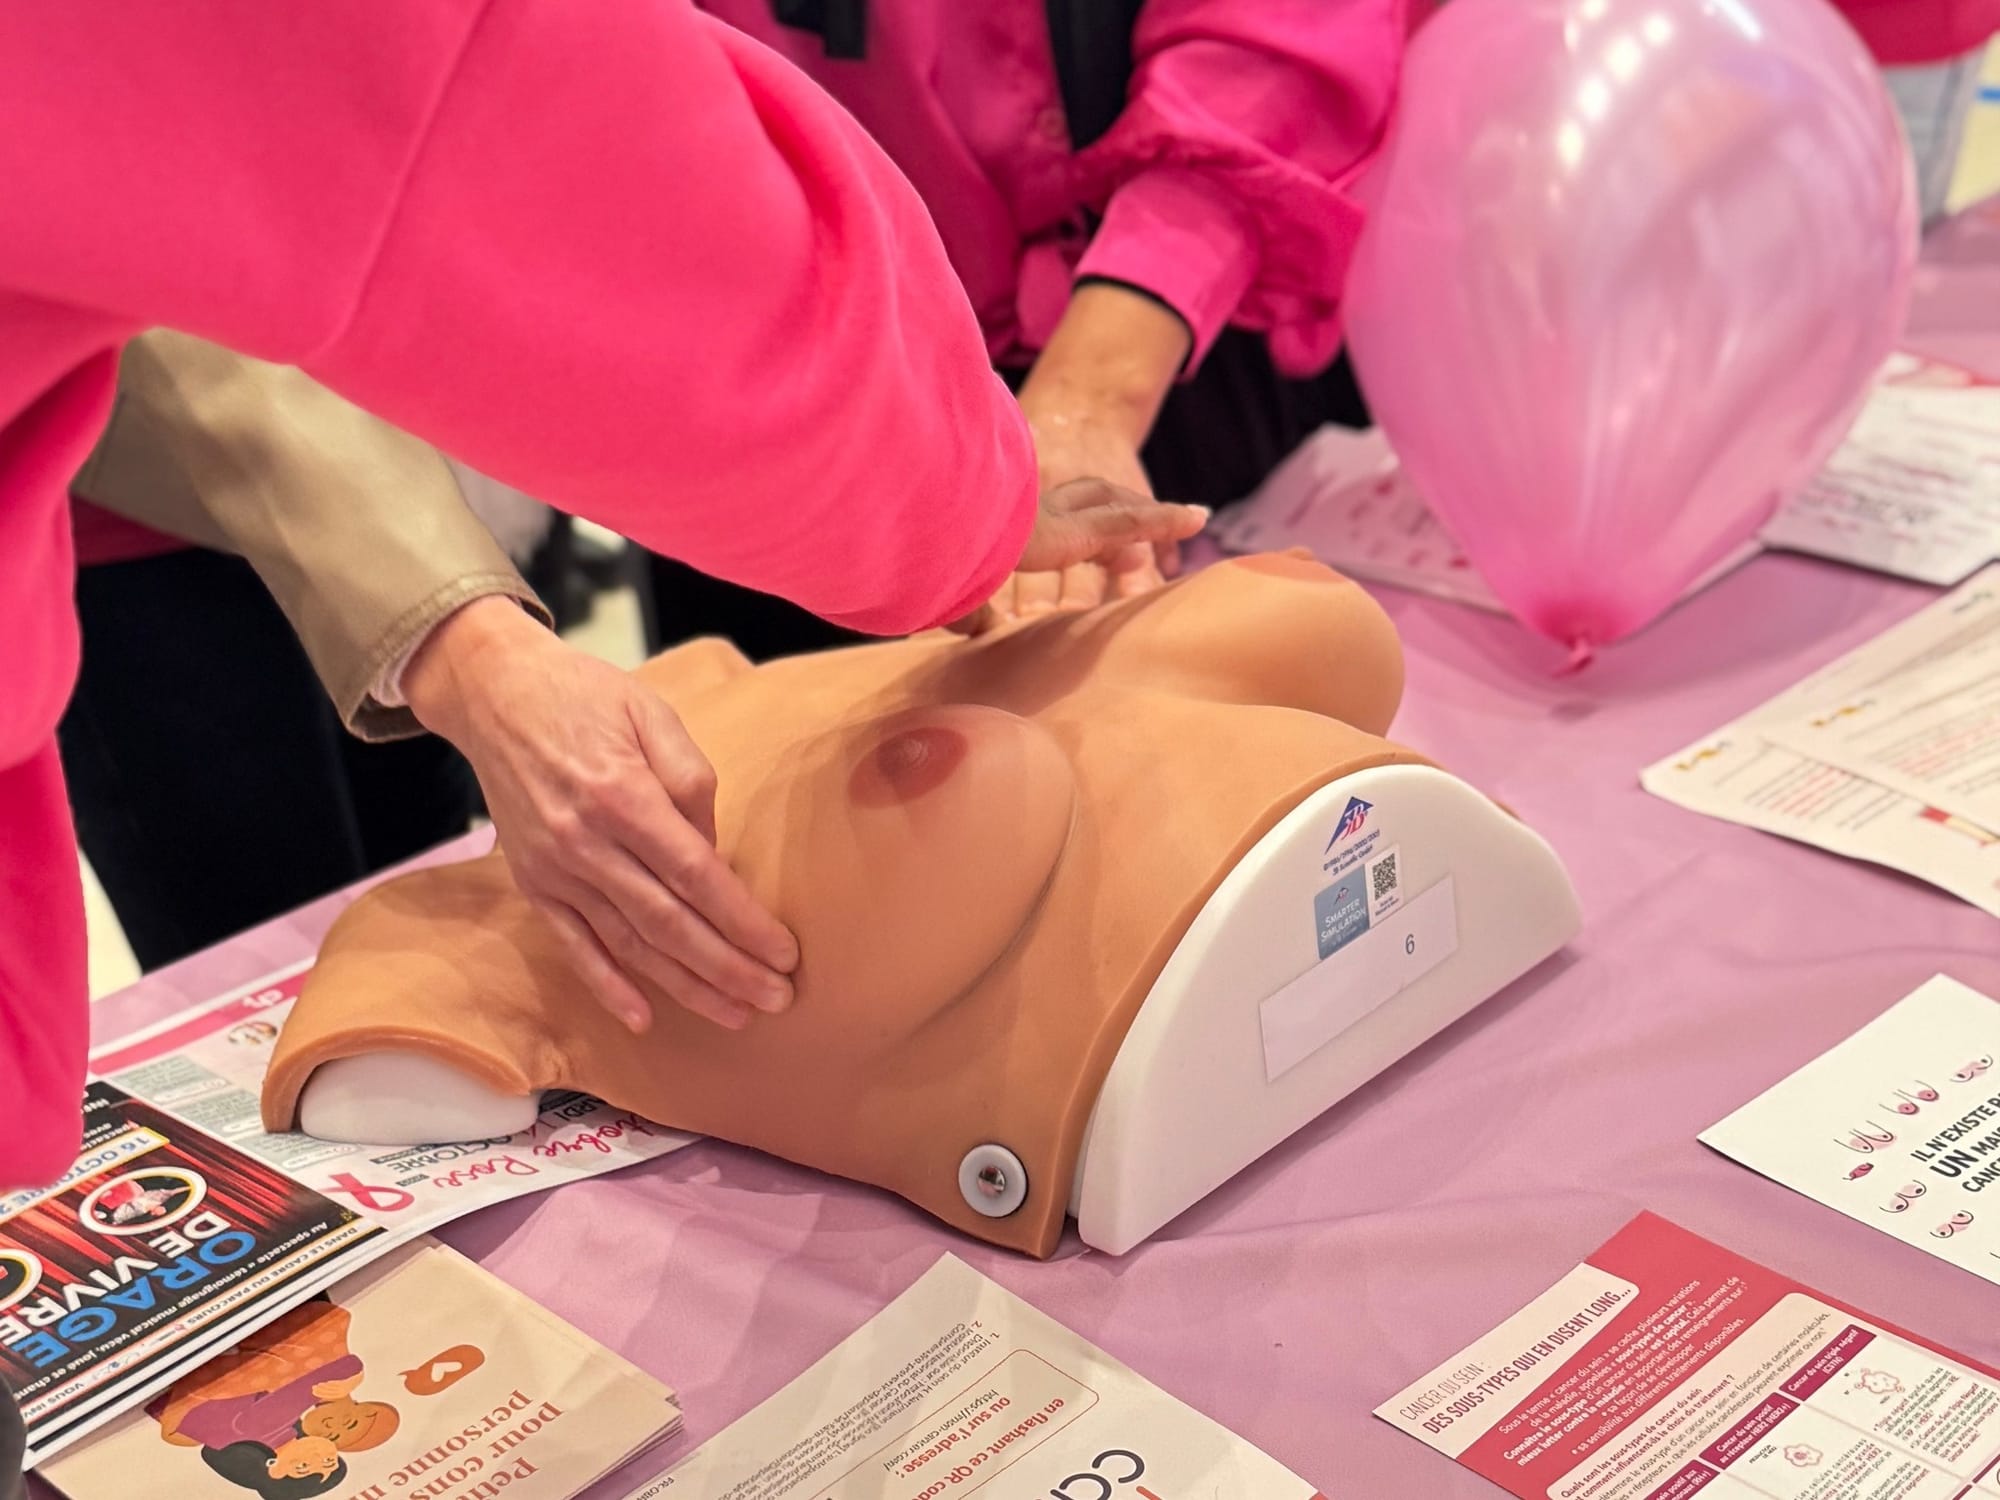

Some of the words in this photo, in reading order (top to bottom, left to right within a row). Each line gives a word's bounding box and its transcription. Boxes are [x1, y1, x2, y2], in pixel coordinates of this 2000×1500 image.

[1322, 908, 1366, 942] SIMULATION
[1326, 900, 1360, 926] SMARTER
[1405, 933, 1416, 955] 6
[554, 1096, 608, 1122] ARDI
[534, 1112, 652, 1155] tobre
[1909, 1147, 1936, 1162] IL
[1924, 1104, 1997, 1151] N'EXISTE
[1985, 1092, 1999, 1107] P
[118, 1135, 150, 1152] 16
[1928, 1148, 1979, 1179] UN
[1969, 1126, 2000, 1156] MAI
[10, 1149, 120, 1205] OCTORE
[1959, 1156, 2000, 1193] CANC
[144, 1210, 233, 1258] DE
[309, 1222, 331, 1233] Au
[323, 1227, 359, 1246] DANS
[253, 1230, 313, 1263] spectacle
[308, 1245, 326, 1255] LE
[269, 1254, 311, 1276] CADRE
[4, 1224, 267, 1368] ORAGE
[173, 1266, 250, 1308] témoignage
[249, 1276, 271, 1287] DU
[0, 1249, 159, 1346] VIVRE
[184, 1287, 252, 1324] PARCOURS
[126, 1306, 180, 1335] musical
[1699, 1316, 1748, 1351] disponibles.
[94, 1332, 133, 1353] vécu,
[1421, 1412, 1455, 1433] DES
[1443, 1365, 1521, 1418] SOUS-TYPES
[1510, 1351, 1541, 1371] QUI
[1530, 1340, 1557, 1356] EN
[1545, 1312, 1595, 1345] DISENT
[1582, 1283, 1633, 1316] LONG...
[1497, 1417, 1522, 1433] Sous
[1516, 1412, 1529, 1420] le
[1524, 1396, 1551, 1414] terme
[1553, 1376, 1580, 1394] cancer
[1574, 1366, 1591, 1376] du
[1585, 1355, 1605, 1368] sein
[1614, 1328, 1641, 1346] cache
[1634, 1305, 1671, 1331] plusieurs
[1662, 1278, 1702, 1306] variations
[49, 1368, 68, 1378] et
[62, 1350, 100, 1370] joué
[1501, 1429, 1544, 1460] Connaître
[1539, 1424, 1552, 1432] le
[1548, 1397, 1590, 1427] sous-type
[1583, 1384, 1605, 1399] d'un
[1601, 1368, 1627, 1387] cancer
[1622, 1359, 1638, 1369] du
[1632, 1347, 1653, 1361] sein
[1647, 1338, 1664, 1350] est
[1658, 1317, 1692, 1340] capital.
[1684, 1304, 1707, 1319] Cela
[1700, 1284, 1733, 1306] permet
[1722, 1275, 1741, 1285] de
[1527, 1417, 1543, 1426] de
[1545, 1388, 1582, 1414] maladie,
[1575, 1364, 1614, 1391] appelées
[1612, 1332, 1657, 1363] sous-types
[1649, 1323, 1666, 1333] de
[1661, 1305, 1690, 1325] cancer
[1651, 1342, 1698, 1376] développer
[1664, 1349, 1707, 1381] traitements
[1785, 1373, 1810, 1391] Cancer
[1803, 1367, 1817, 1375] du
[1821, 1345, 1843, 1359] triple
[1834, 1328, 1862, 1348] négatif
[8, 1376, 54, 1400] chant
[1397, 1388, 1447, 1420] CANCER
[1435, 1378, 1463, 1394] DU
[1450, 1362, 1485, 1384] SEIN
[1514, 1446, 1543, 1466] mieux
[1537, 1429, 1565, 1448] lutter
[1560, 1411, 1589, 1432] contre
[1584, 1405, 1597, 1413] la
[1592, 1383, 1626, 1407] maladie
[1623, 1376, 1636, 1384] en
[1631, 1349, 1672, 1378] apportant
[1664, 1338, 1683, 1351] des
[1675, 1297, 1737, 1341] renseignements
[1728, 1287, 1745, 1298] sur
[1632, 1380, 1648, 1390] de
[1644, 1373, 1658, 1383] se
[46, 1382, 84, 1403] VOUS
[987, 1396, 1012, 1413] ou
[1042, 1397, 1067, 1414] en
[1606, 1404, 1619, 1412] sa
[1612, 1388, 1639, 1406] façon
[1630, 1379, 1669, 1406] différents
[19, 1402, 48, 1418] INV
[964, 1410, 993, 1429] sur
[1620, 1405, 1638, 1417] aux
[386, 1389, 533, 1488] personne
[483, 1401, 563, 1459] pour
[985, 1411, 1049, 1455] flashant
[1559, 1479, 1586, 1498] Quels
[1581, 1468, 1601, 1482] sont
[1596, 1459, 1612, 1470] les
[1607, 1431, 1648, 1462] sous-types
[1642, 1423, 1656, 1433] de
[1653, 1407, 1678, 1425] cancer
[1673, 1398, 1688, 1407] du
[1683, 1387, 1703, 1400] sein
[1581, 1471, 1616, 1498] comment
[1610, 1434, 1661, 1473] influencent-ils
[1655, 1428, 1668, 1436] le
[1663, 1414, 1686, 1430] choix
[1682, 1406, 1696, 1415] du
[1691, 1379, 1730, 1408] traitement
[1583, 1414, 1624, 1444] sensibilité
[1714, 1434, 1739, 1452] Cancer
[1732, 1427, 1747, 1436] du
[1751, 1403, 1775, 1420] positif
[901, 1427, 971, 1473] l'adresse
[967, 1451, 990, 1467] ce
[1577, 1442, 1590, 1451] sa
[1637, 1444, 1673, 1471] sous-type
[406, 1454, 487, 1500] cons
[941, 1462, 975, 1485] QR
